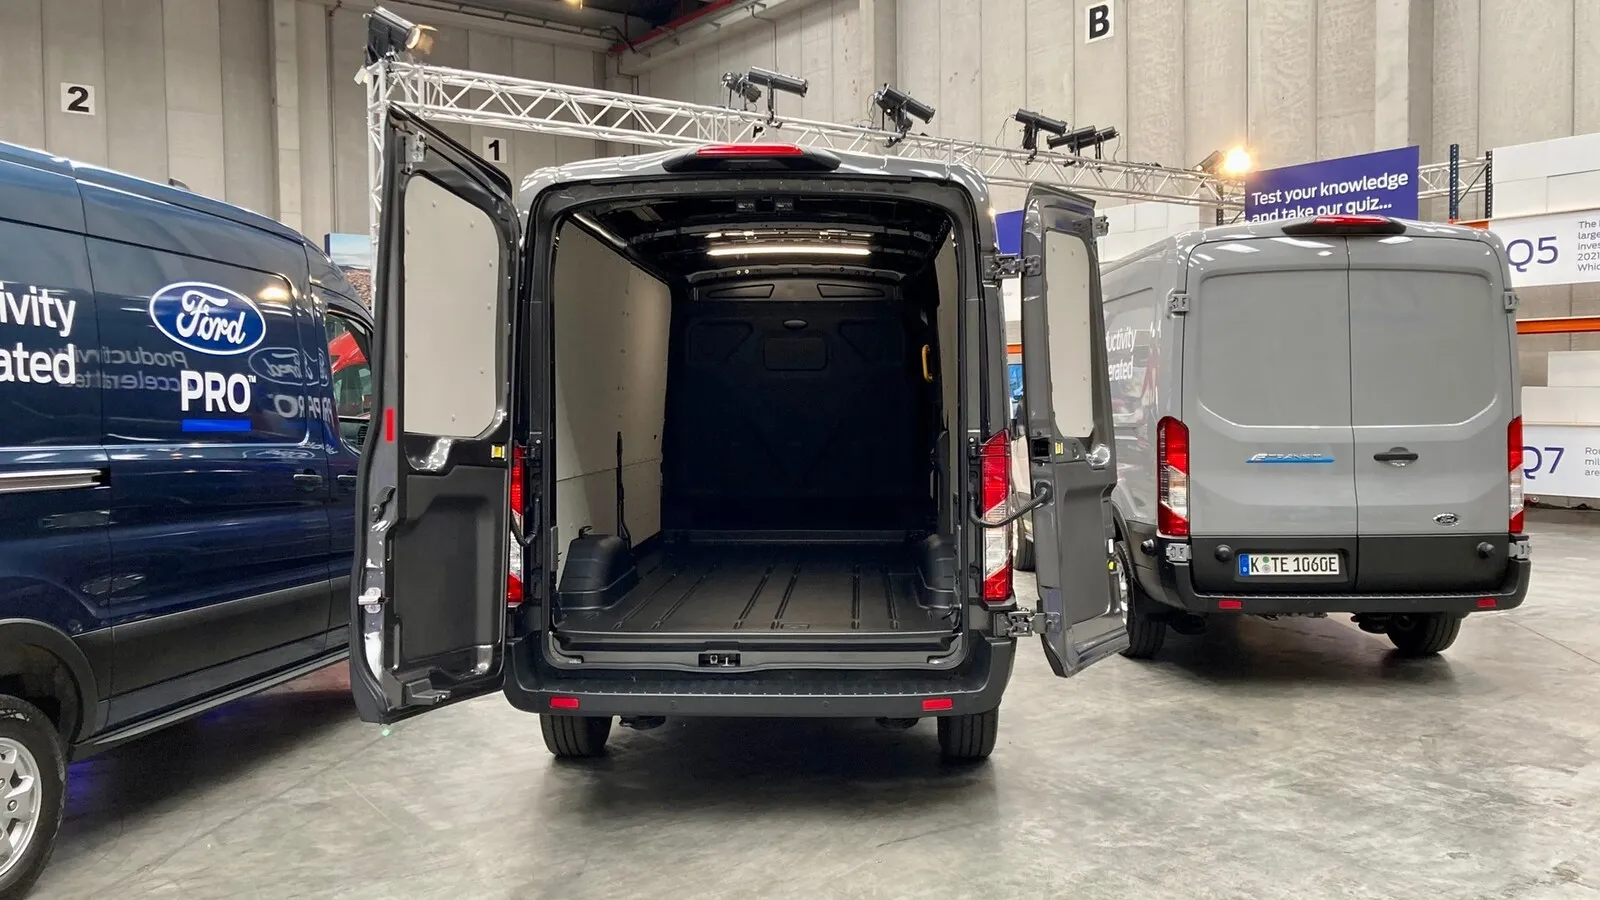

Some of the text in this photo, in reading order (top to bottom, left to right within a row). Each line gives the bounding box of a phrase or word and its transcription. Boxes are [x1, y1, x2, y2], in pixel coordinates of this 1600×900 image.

[1089, 4, 1110, 40] B
[67, 86, 89, 113] 2
[488, 139, 500, 161] 1
[1252, 172, 1409, 206] Test your knowledge
[1251, 197, 1393, 223] and take our quiz...
[1577, 220, 1597, 229] The
[1505, 235, 1559, 273] Q5
[0, 282, 77, 338] ivity
[176, 290, 246, 345] Ford
[1105, 326, 1137, 353] uctivity
[0, 342, 77, 385] ated
[180, 370, 251, 414] PRO
[1522, 446, 1565, 480] Q7
[1250, 557, 1260, 573] K
[1271, 557, 1290, 573] TE
[1293, 556, 1338, 573] 1060E
